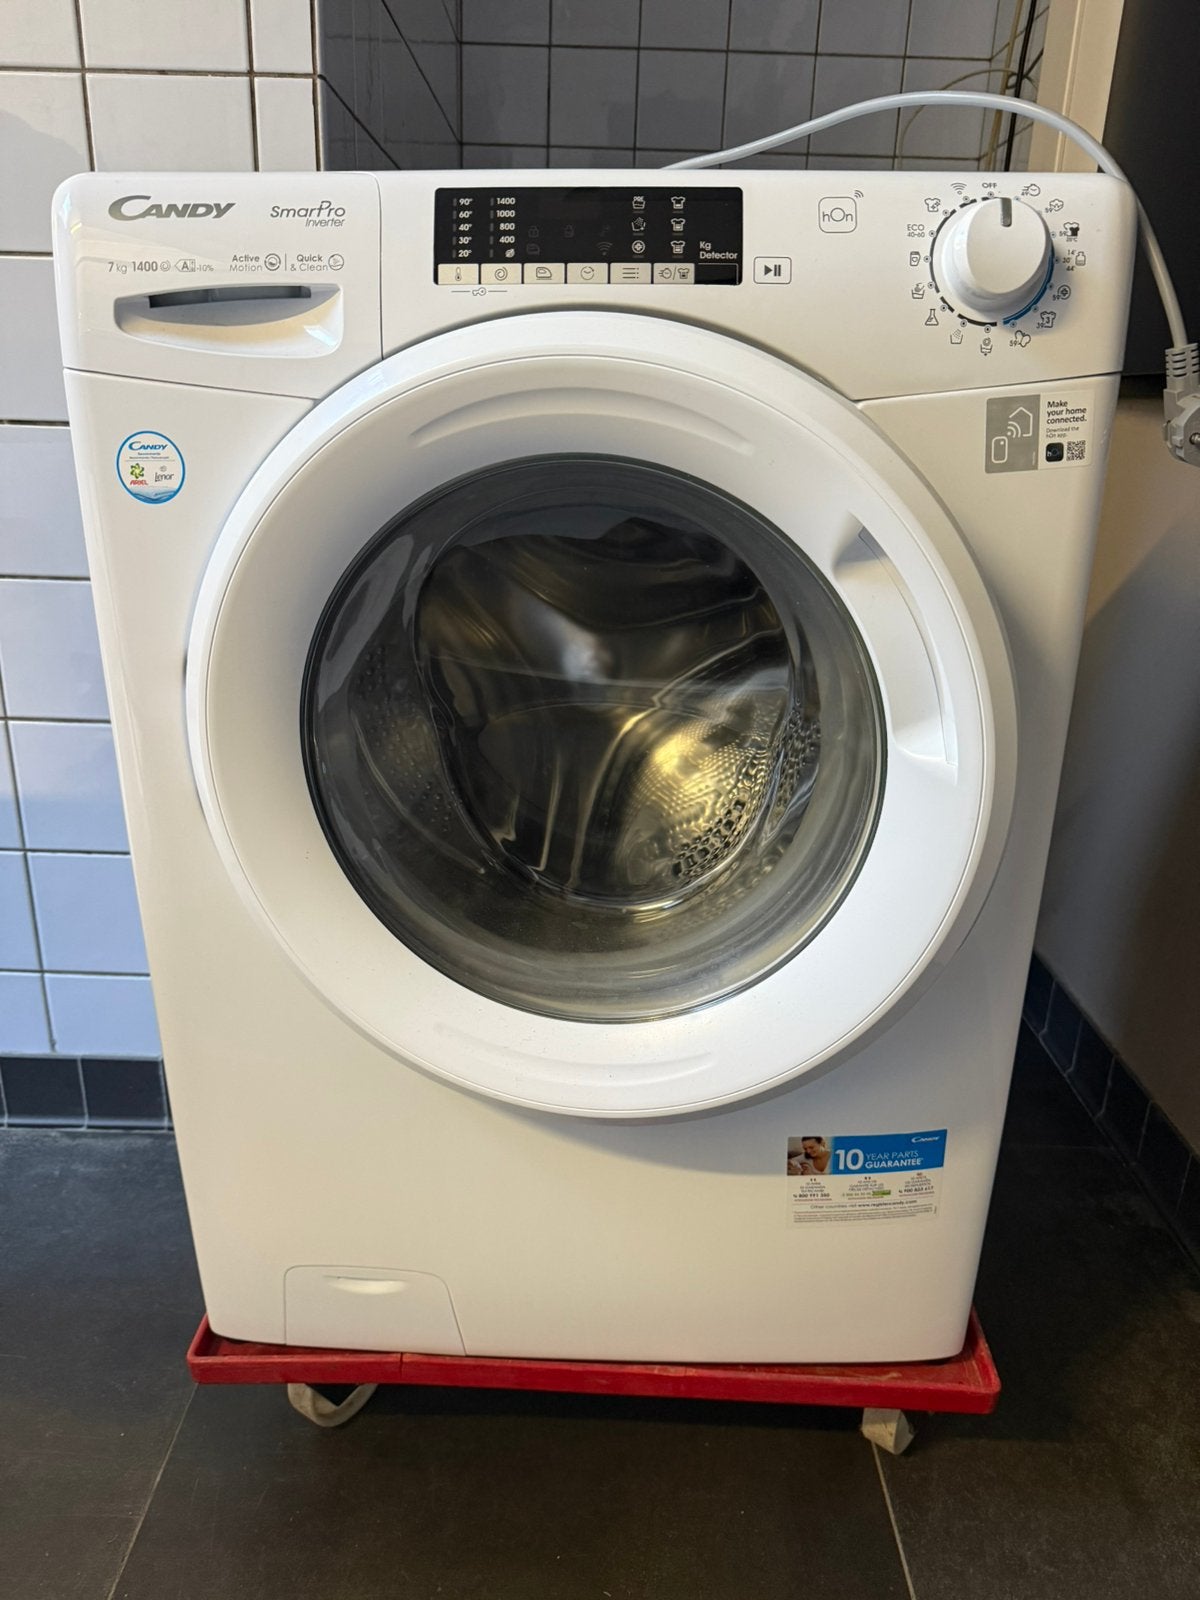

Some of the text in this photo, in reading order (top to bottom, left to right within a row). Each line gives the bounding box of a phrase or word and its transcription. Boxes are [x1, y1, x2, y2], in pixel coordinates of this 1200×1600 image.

[822, 207, 853, 222] hOn
[304, 217, 345, 227] Inverter
[700, 241, 711, 250] Kg
[232, 254, 260, 262] Active
[296, 254, 323, 263] Quick
[108, 262, 128, 274] 7 kg
[132, 261, 158, 272] 1400
[181, 262, 189, 271] A
[230, 263, 263, 272] Motion
[299, 263, 328, 272] Clean
[1046, 406, 1087, 418] your home
[1046, 414, 1087, 424] connected.
[835, 1149, 864, 1170] 10
[865, 1150, 919, 1161] YEAR PARTS
